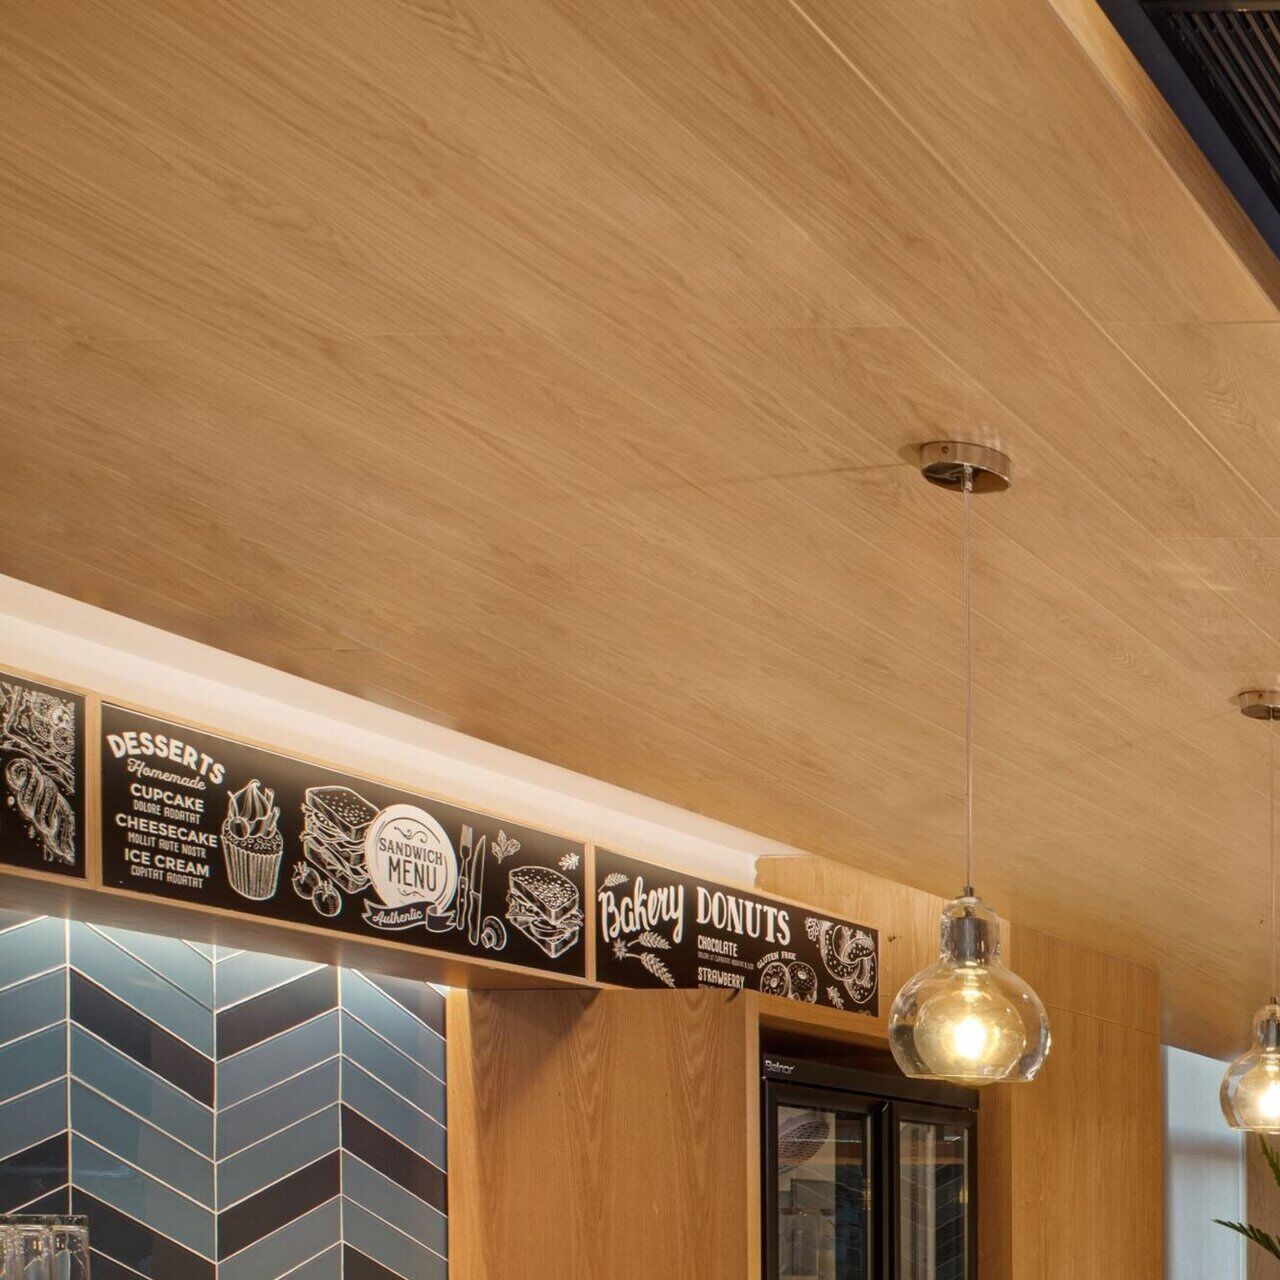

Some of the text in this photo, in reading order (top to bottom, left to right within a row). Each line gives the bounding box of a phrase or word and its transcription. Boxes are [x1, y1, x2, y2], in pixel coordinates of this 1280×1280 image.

[107, 731, 226, 785] DESSERTS
[127, 757, 206, 791] Homemade
[130, 783, 205, 812] CUPCAKE
[115, 813, 218, 848] CHEESECAKE
[124, 847, 210, 878] ICE CREAM
[379, 837, 443, 866] SANDWICH
[388, 856, 437, 892] MENU
[372, 907, 424, 927] Authentic
[598, 875, 685, 945] Bakery
[696, 886, 792, 946] DONUTS
[697, 934, 739, 957] CHOCOLATE
[756, 950, 780, 970] GLUTEN
[780, 950, 798, 961] FREE
[697, 966, 745, 989] STRAWBERRY
